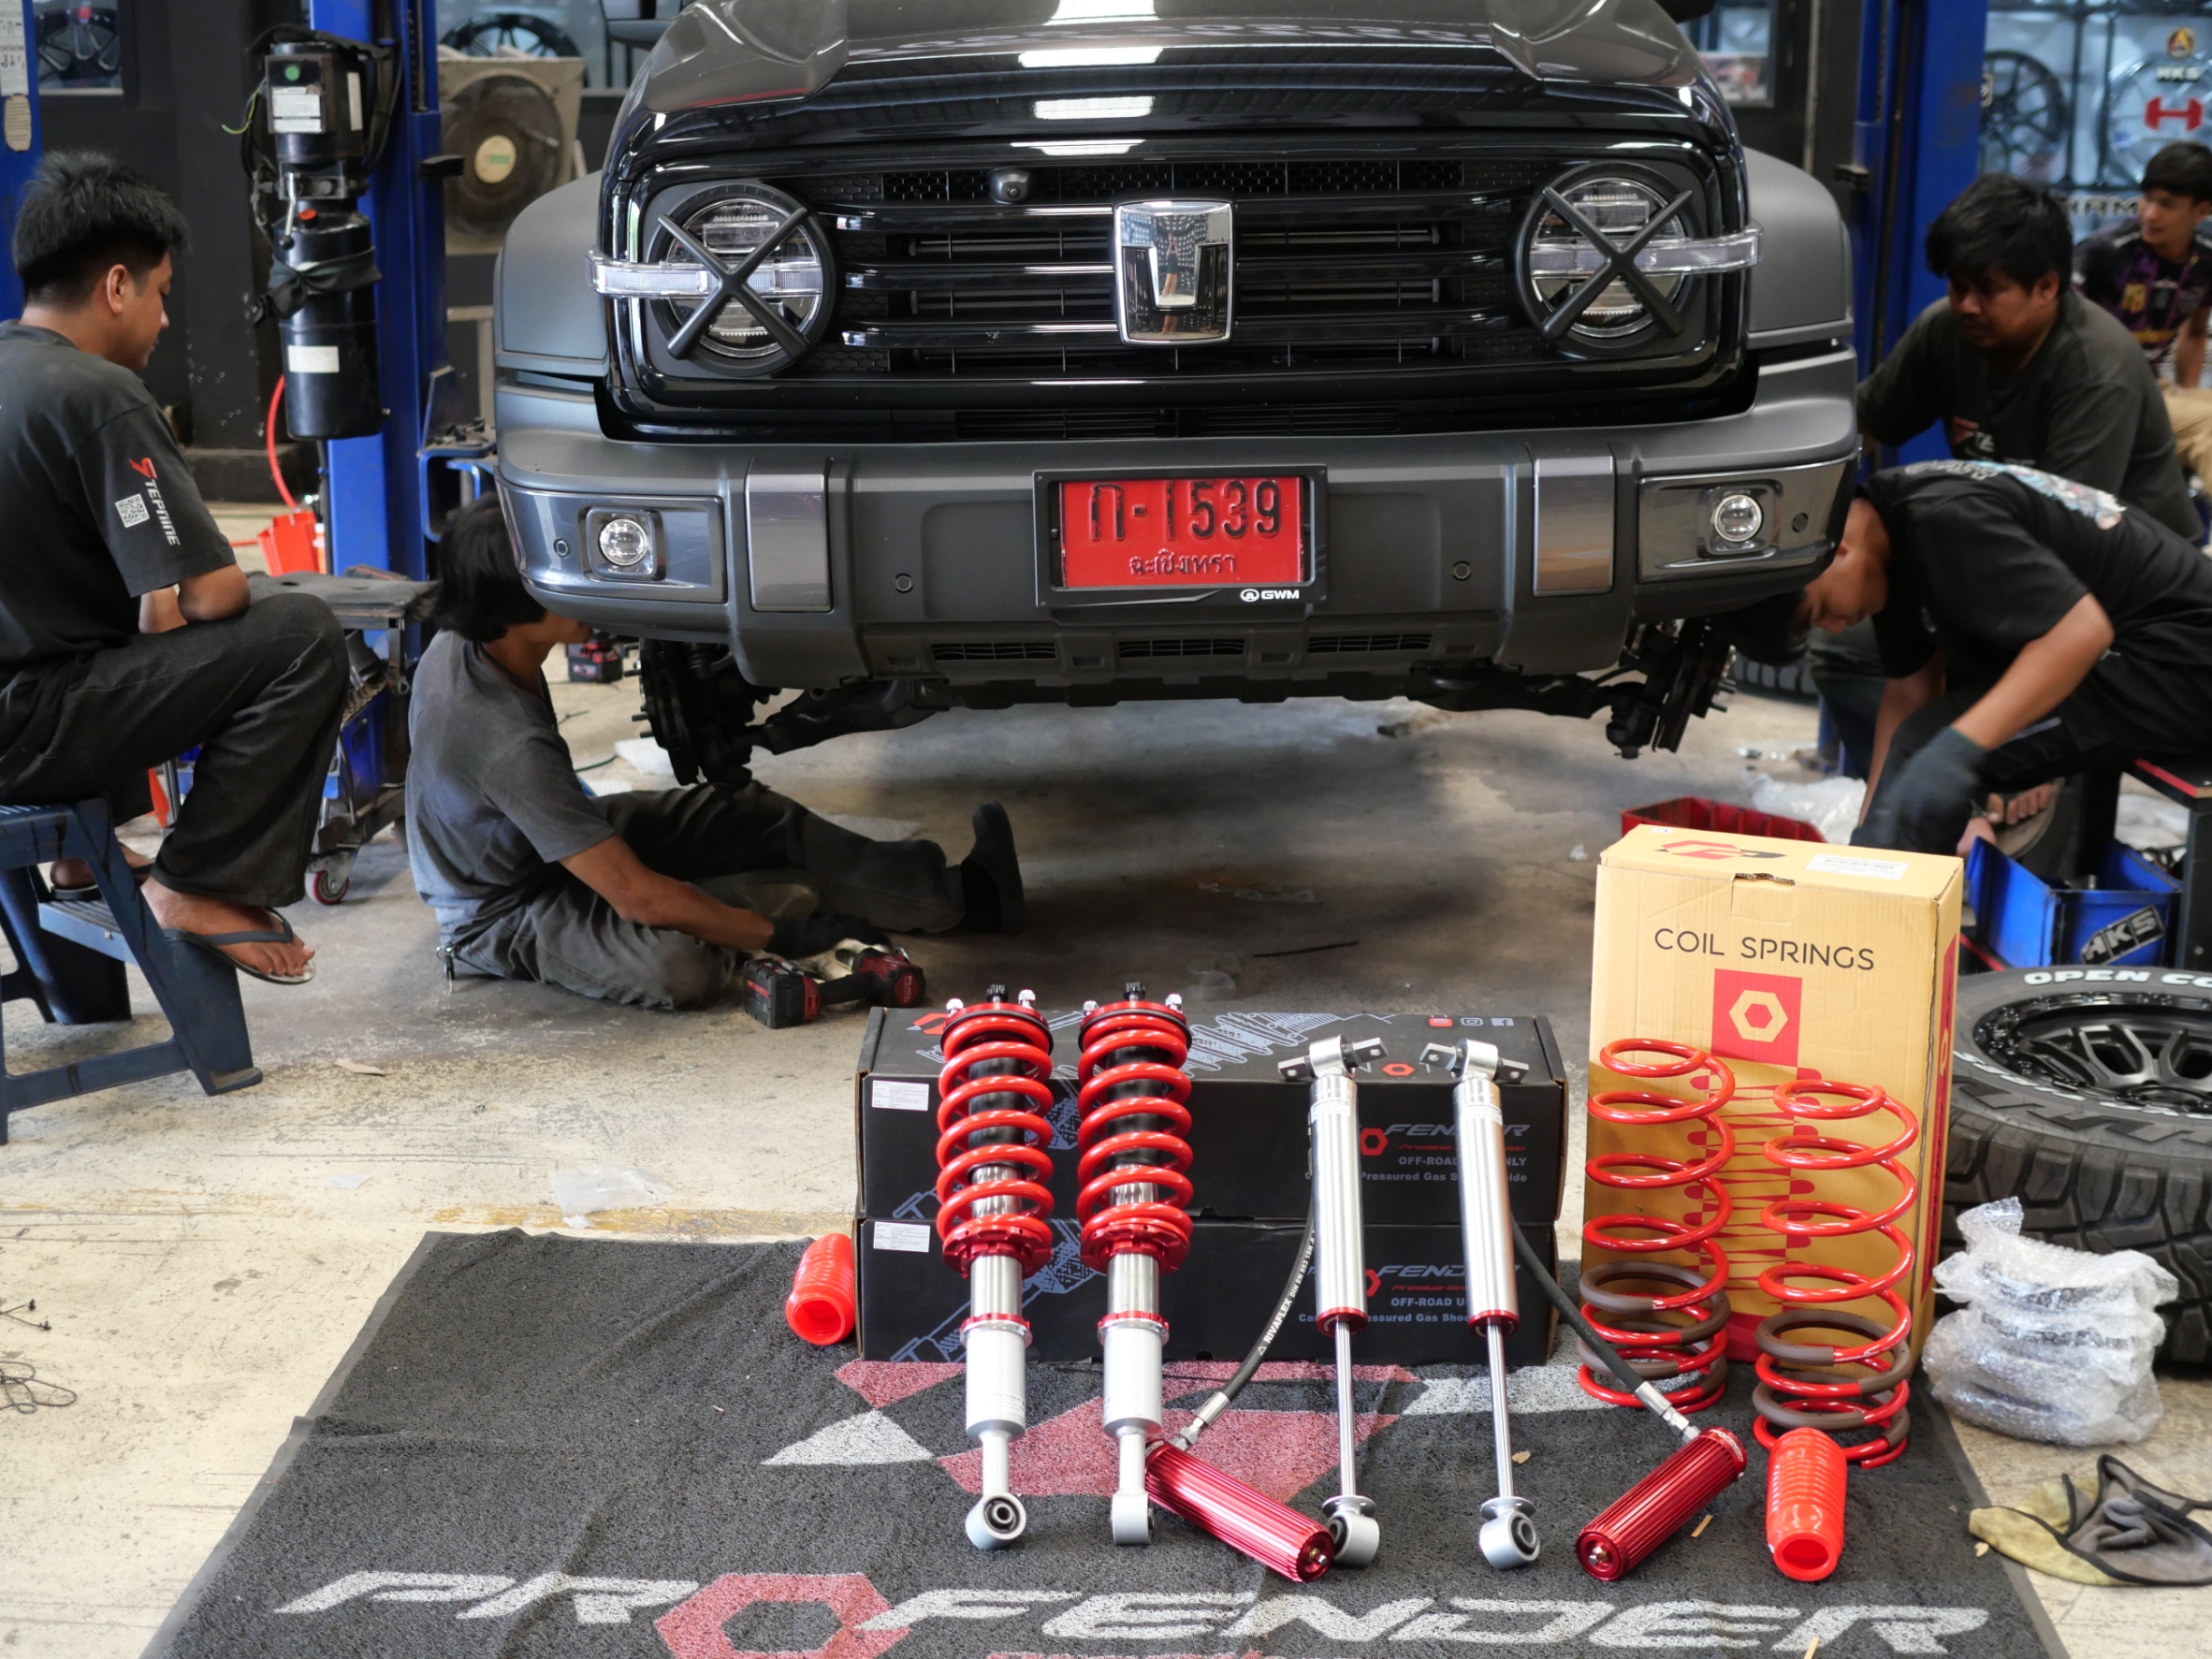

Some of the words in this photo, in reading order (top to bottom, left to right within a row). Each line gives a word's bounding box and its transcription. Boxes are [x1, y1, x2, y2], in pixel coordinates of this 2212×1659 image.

[1128, 547, 1237, 576] ฉะเชิงเทรา
[1260, 589, 1301, 600] GWM
[1654, 927, 1725, 957] COIL
[1740, 937, 1875, 972] SPRINGS
[2024, 969, 2152, 985] OPEN
[1505, 1157, 1528, 1167] NLY
[1423, 1171, 1447, 1182] Gas
[1390, 1297, 1453, 1307] OFF-ROAD
[1263, 1297, 1293, 1345] RIVAFLEX
[1289, 1283, 1300, 1299] DIN
[1295, 1273, 1304, 1286] EN
[1366, 1313, 1412, 1323] essured
[1416, 1313, 1439, 1323] Gas
[1442, 1313, 1469, 1323] Shoc
